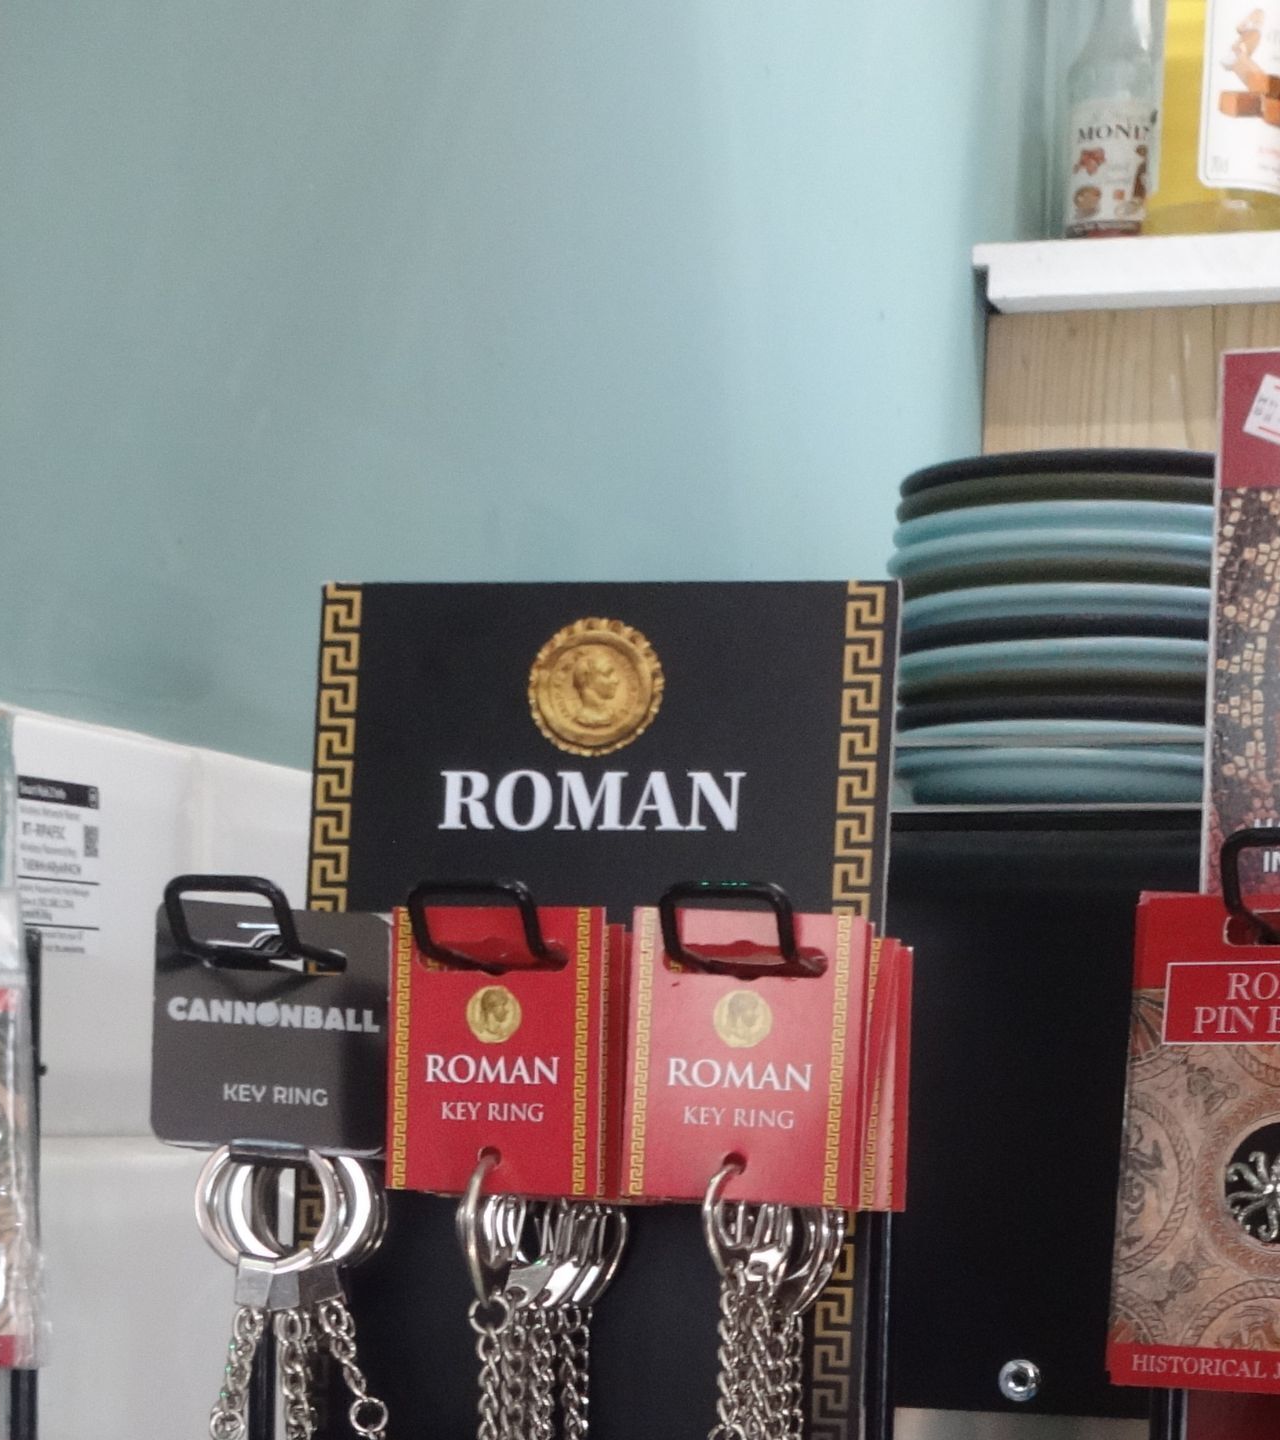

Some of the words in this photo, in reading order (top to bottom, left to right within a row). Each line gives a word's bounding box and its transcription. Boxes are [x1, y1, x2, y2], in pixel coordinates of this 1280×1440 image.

[437, 770, 747, 832] ROMAN
[167, 996, 381, 1034] CANNONBALL
[1193, 1005, 1260, 1035] PIN
[426, 1054, 560, 1087] ROMAN
[667, 1057, 813, 1093] ROMAN
[223, 1083, 267, 1105] KEY
[273, 1085, 329, 1108] RING
[441, 1101, 483, 1123] KEY
[488, 1102, 545, 1124] RING
[683, 1105, 727, 1128] KEY
[733, 1107, 795, 1130] RING
[1131, 1354, 1267, 1380] HISTORICAL
